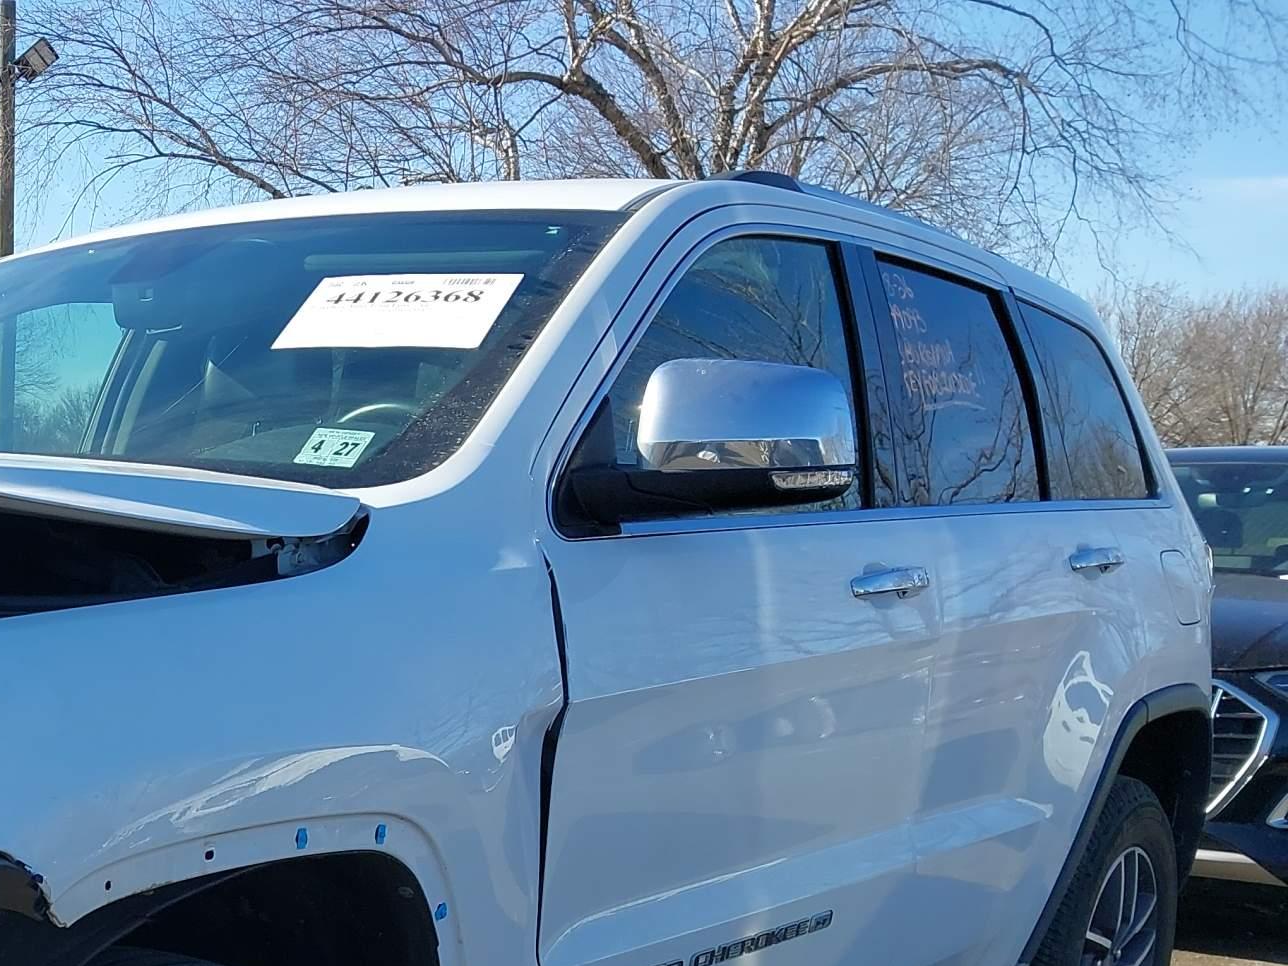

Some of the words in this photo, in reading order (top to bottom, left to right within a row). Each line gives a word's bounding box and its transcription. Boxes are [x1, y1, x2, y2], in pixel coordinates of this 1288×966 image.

[327, 290, 485, 304] 44126368
[311, 439, 326, 454] 4
[332, 441, 361, 456] 27
